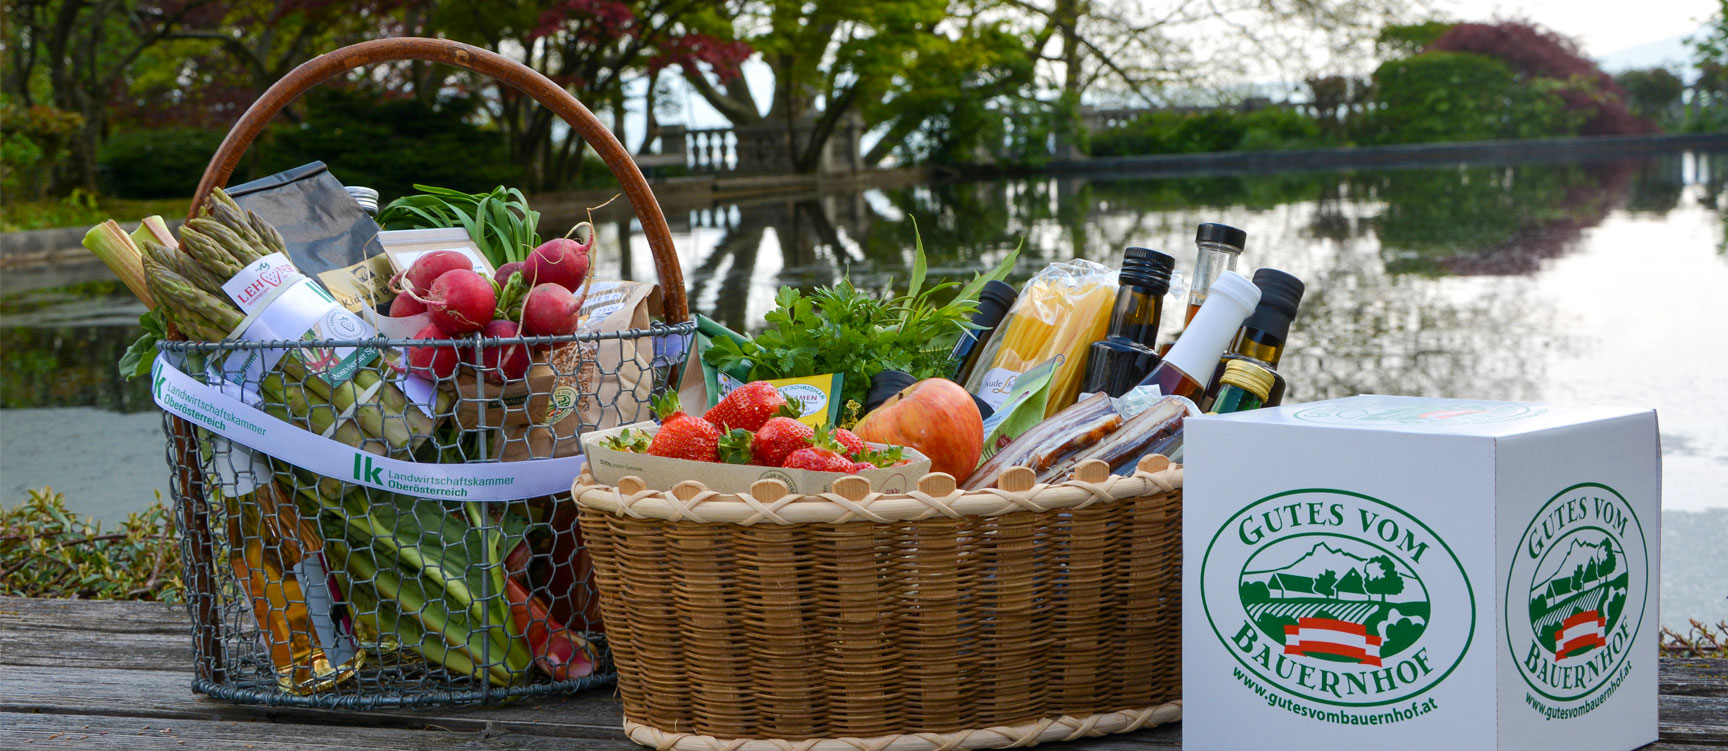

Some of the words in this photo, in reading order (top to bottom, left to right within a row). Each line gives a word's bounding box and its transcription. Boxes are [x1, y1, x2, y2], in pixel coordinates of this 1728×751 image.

[164, 393, 226, 431] Oberösterreich
[167, 381, 267, 436] Landwirtschaftskammer
[388, 470, 515, 487] Landwirtschaftskammer
[388, 480, 468, 497] Oberösterreich
[1238, 501, 1345, 546] GUTES
[1358, 508, 1430, 564] VOM
[1528, 496, 1587, 560] GUTES
[1594, 497, 1629, 538] VOM
[1231, 620, 1434, 698] BAUERNHOF
[1524, 615, 1631, 690] BAUERNHOF
[1232, 666, 1438, 726] www.gutesvombauernhof.at
[1525, 660, 1632, 721] www.gutesvombauernhof.at
